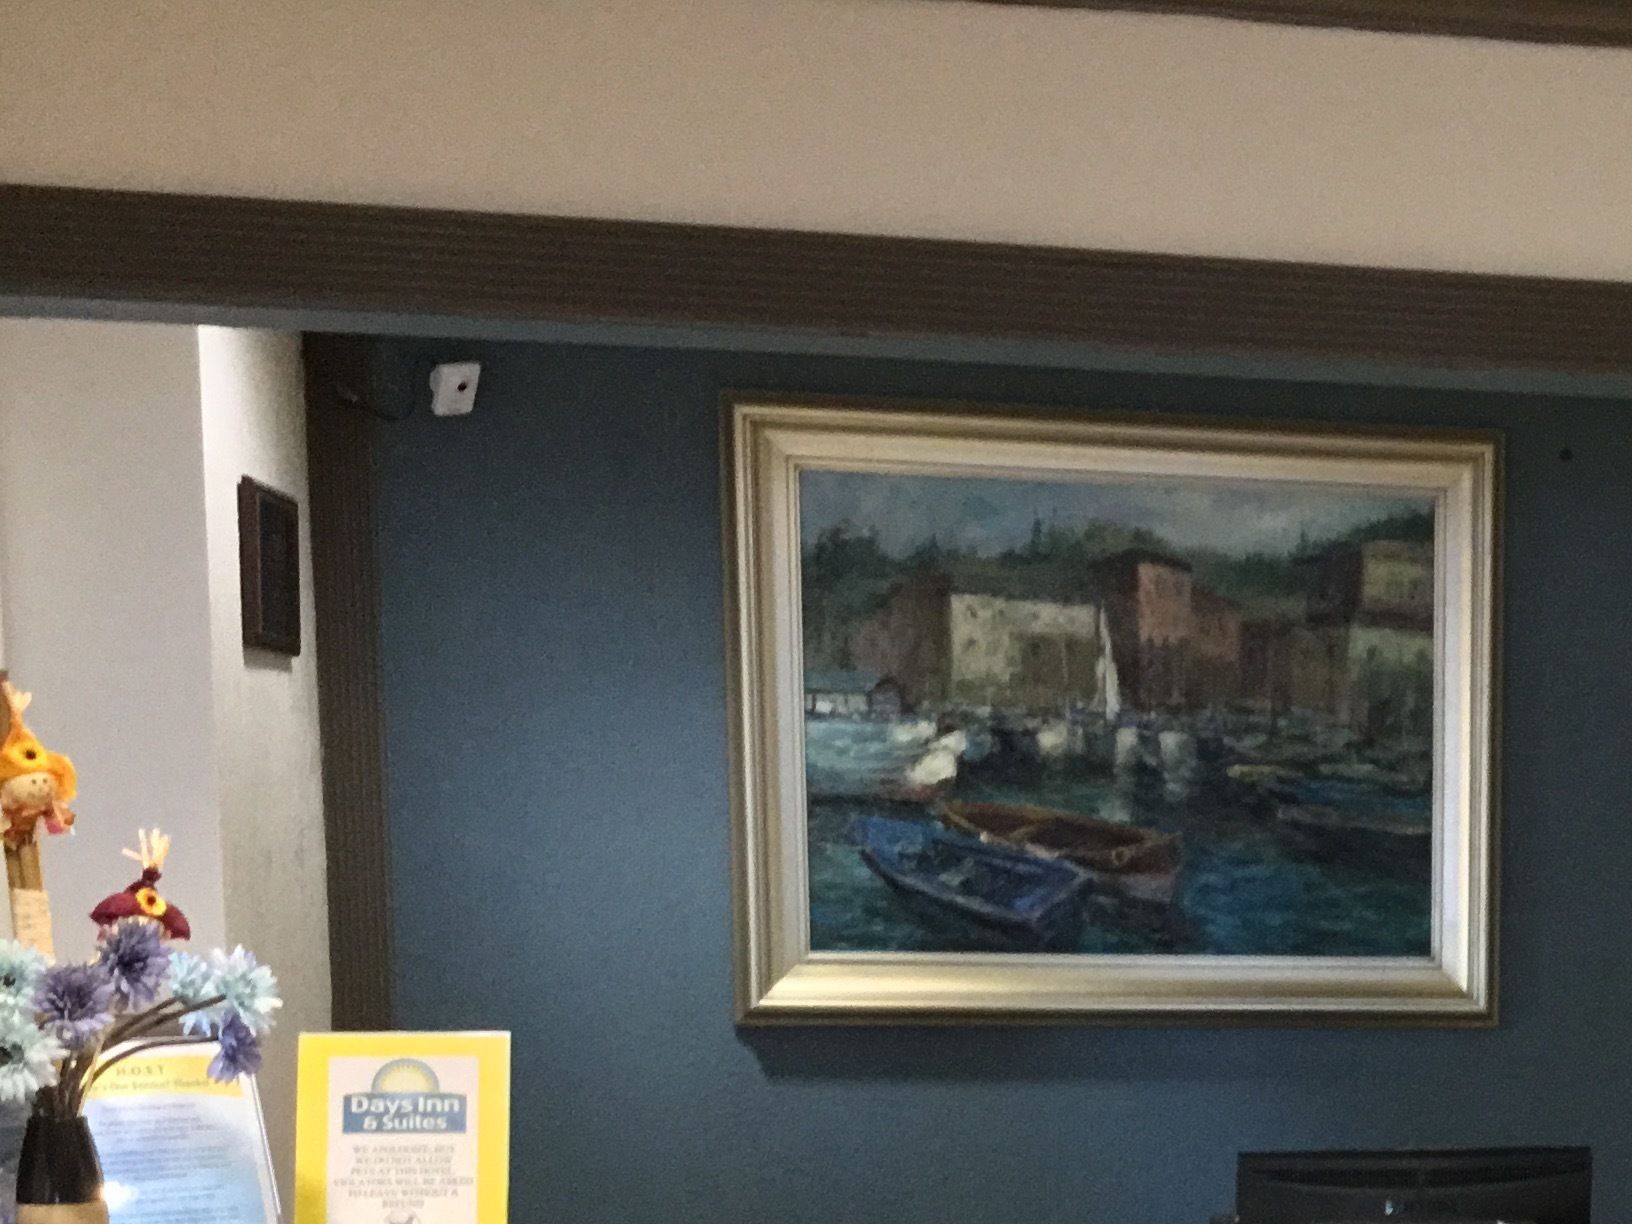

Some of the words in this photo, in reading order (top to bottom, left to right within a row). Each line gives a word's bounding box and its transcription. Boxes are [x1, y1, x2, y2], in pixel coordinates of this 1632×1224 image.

[350, 1095, 413, 1119] Days
[416, 1096, 460, 1113] Inn
[363, 1115, 378, 1131] &
[382, 1113, 447, 1131] Suites
